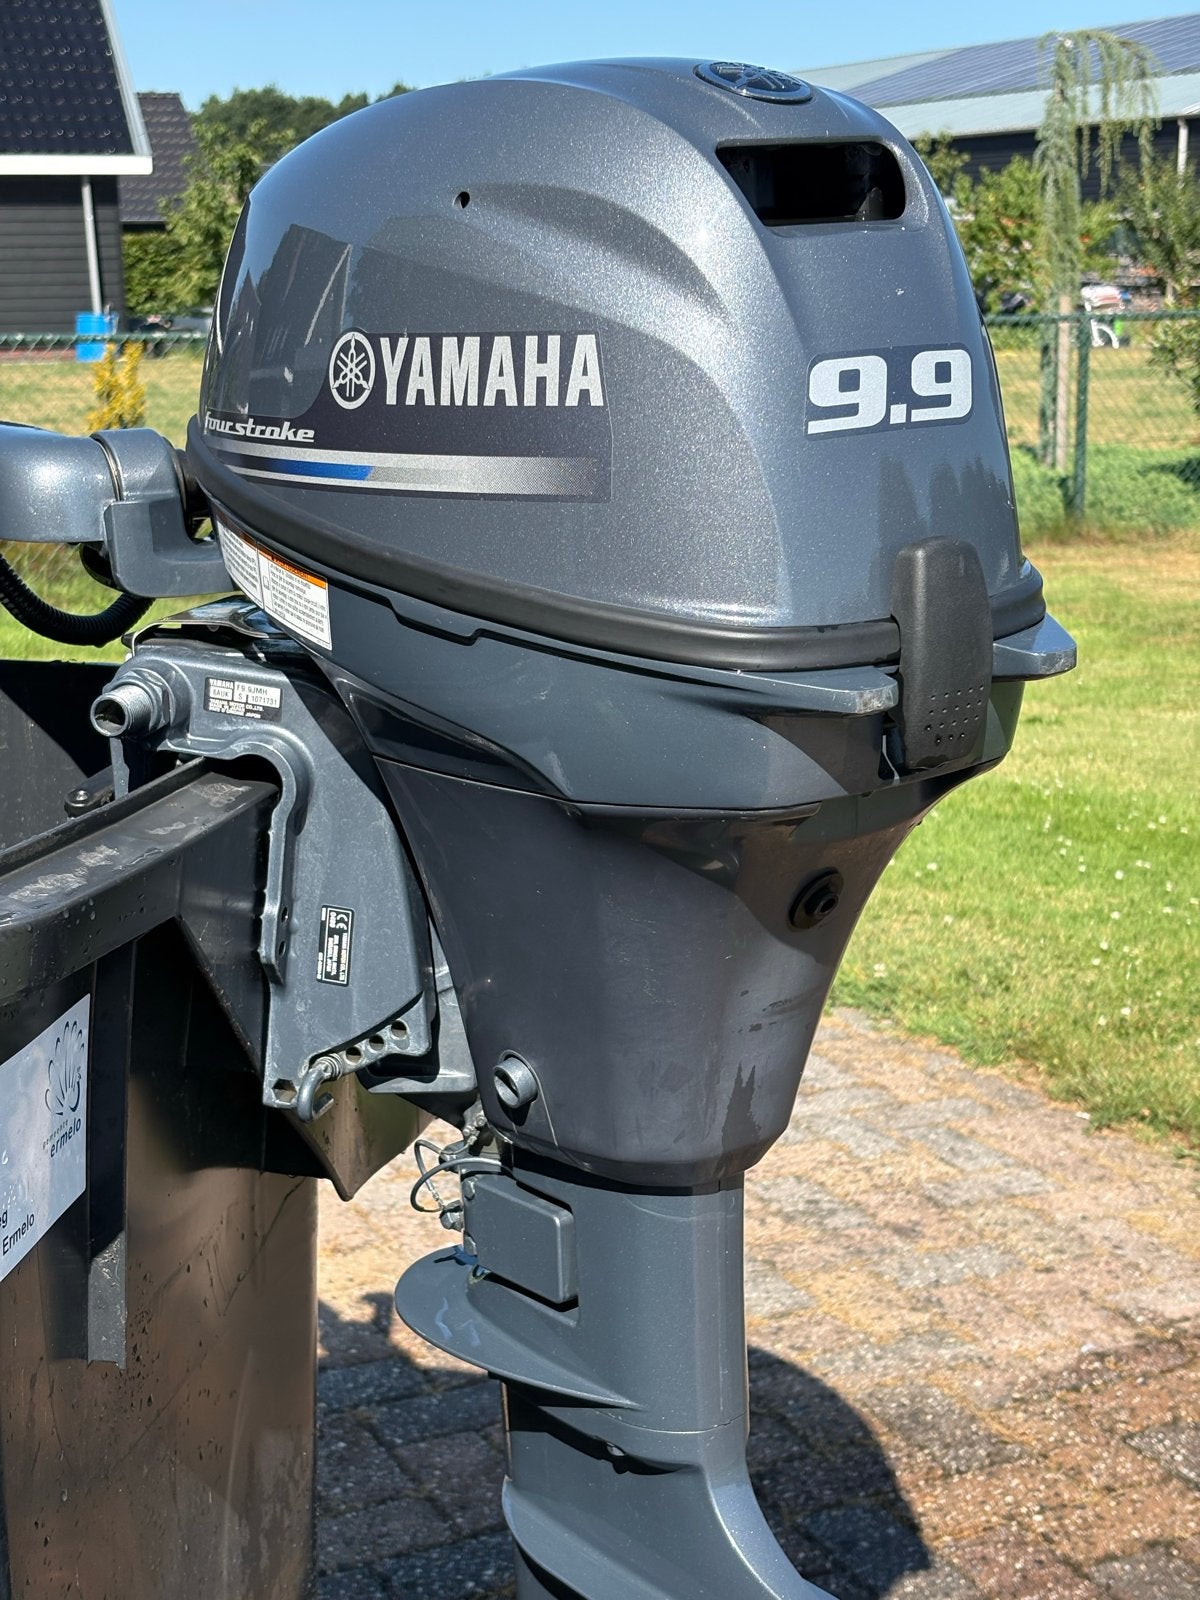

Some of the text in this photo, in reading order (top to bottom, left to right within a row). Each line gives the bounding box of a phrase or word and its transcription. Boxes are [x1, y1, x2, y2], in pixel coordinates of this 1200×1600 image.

[380, 333, 605, 407] YAMAHA
[807, 349, 973, 435] 9.9
[209, 679, 233, 689] YAMAHA
[251, 695, 277, 705] 1071731
[50, 1117, 82, 1158] ermelo
[2, 1213, 35, 1257] Ermelo
